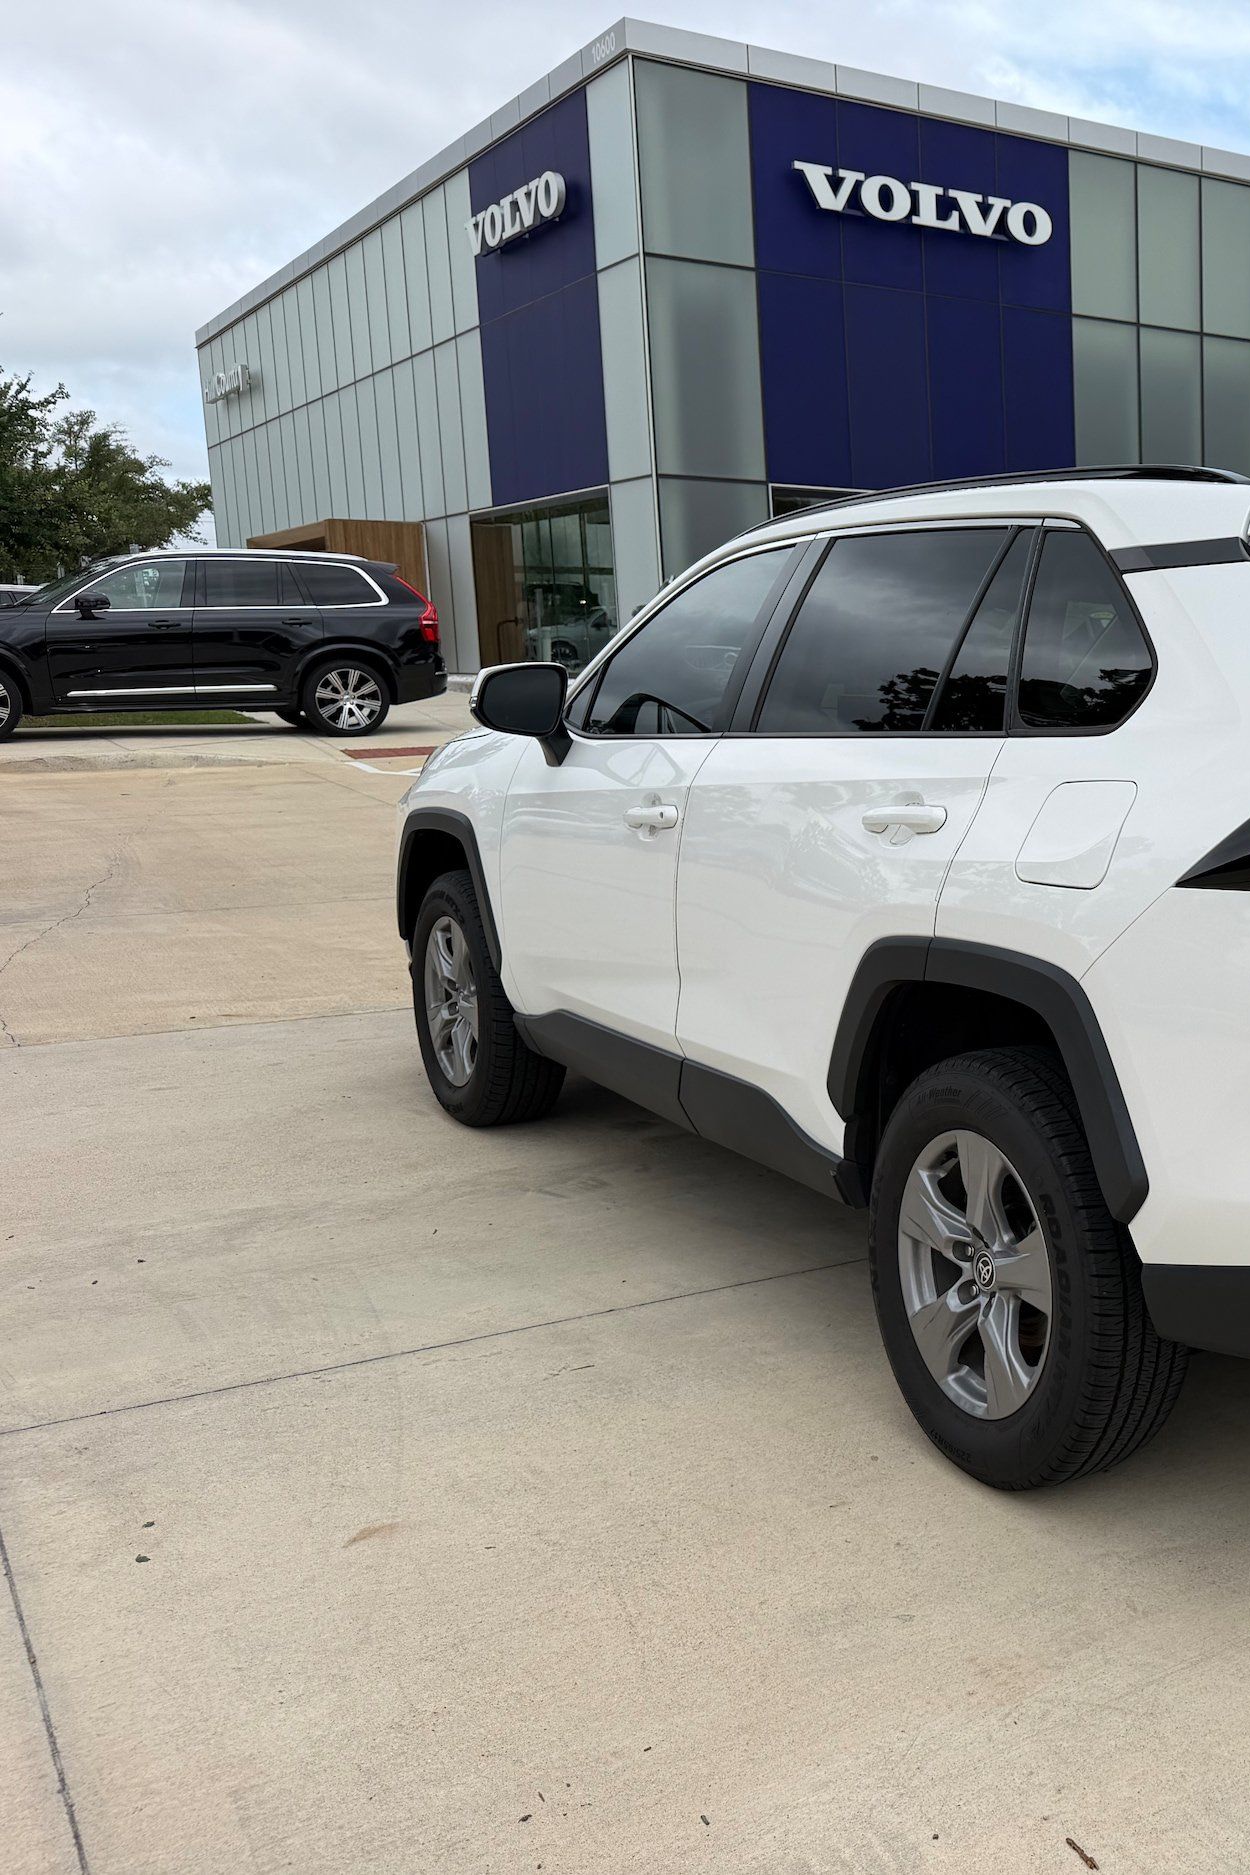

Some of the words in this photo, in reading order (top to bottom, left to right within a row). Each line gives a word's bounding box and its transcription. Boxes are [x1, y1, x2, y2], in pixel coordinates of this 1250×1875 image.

[591, 32, 616, 64] 10600
[464, 171, 565, 257] VOLVO
[792, 160, 1053, 246] VOLVO
